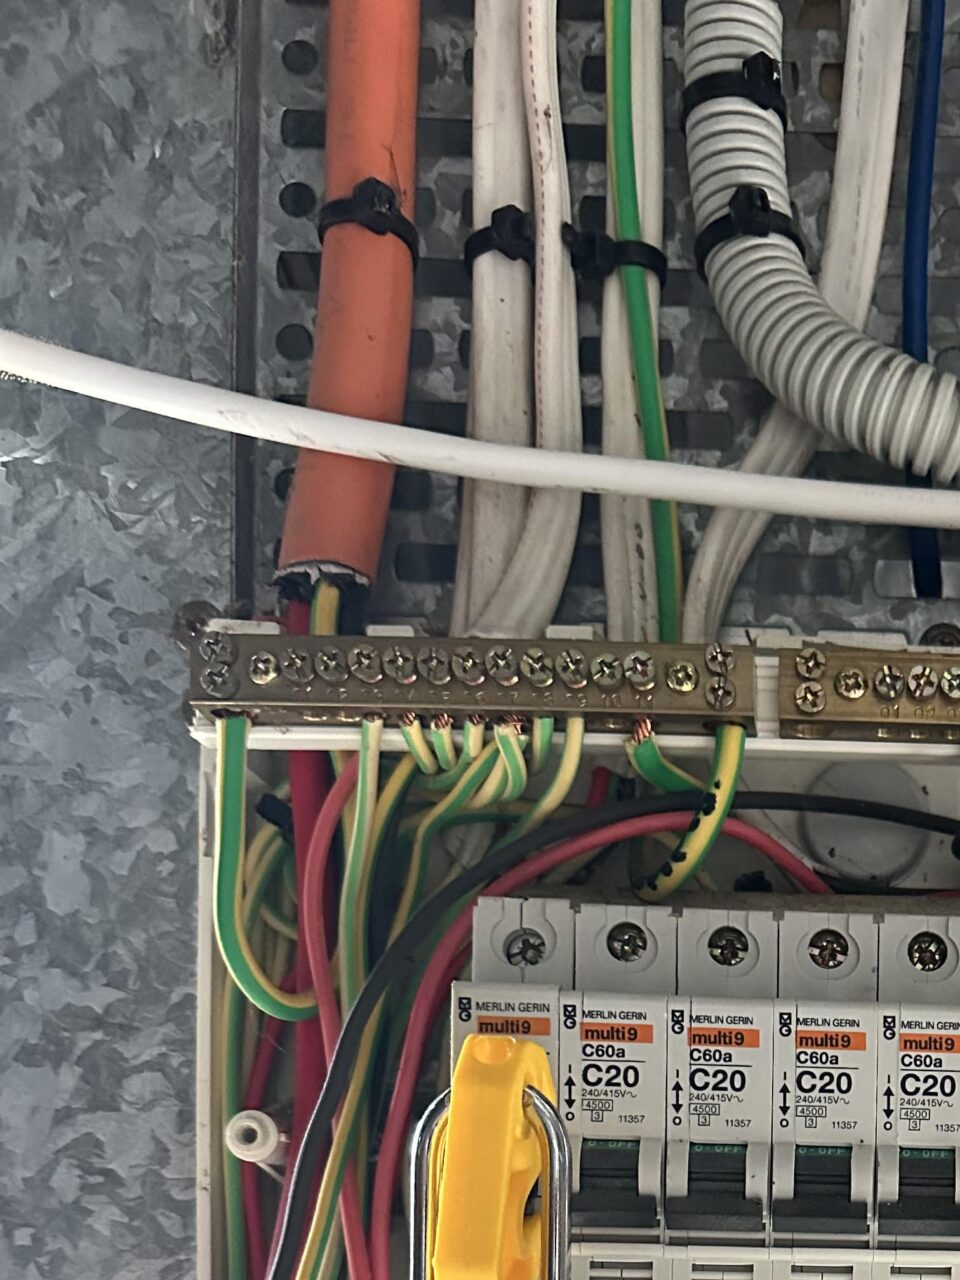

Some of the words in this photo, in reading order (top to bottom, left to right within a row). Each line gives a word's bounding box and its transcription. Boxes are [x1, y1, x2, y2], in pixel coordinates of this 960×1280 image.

[476, 1001, 515, 1012] MERLIN
[518, 1003, 550, 1012] GERIN
[582, 1010, 616, 1020] MERLIN
[619, 1011, 647, 1021] GERIN
[690, 1015, 723, 1025] MERLIN
[726, 1015, 754, 1025] GERIN
[797, 1017, 830, 1027] MERLIN
[833, 1018, 860, 1028] GERIN
[901, 1020, 934, 1030] MERLIN
[582, 1044, 625, 1058] C60a
[689, 1048, 732, 1063] C60a
[796, 1051, 839, 1065] C60a
[900, 1054, 943, 1068] C60a
[582, 1063, 640, 1088] C20
[689, 1068, 746, 1092] C20
[796, 1070, 853, 1094] C20
[900, 1073, 956, 1097] C20
[585, 1101, 611, 1110] 4500
[692, 1105, 718, 1114] 4500
[799, 1107, 824, 1116] 4500
[903, 1110, 928, 1119] 4500
[618, 1115, 645, 1123] 11357
[725, 1119, 751, 1127] 11357
[831, 1121, 858, 1129] 11357
[935, 1124, 960, 1132] 11357
